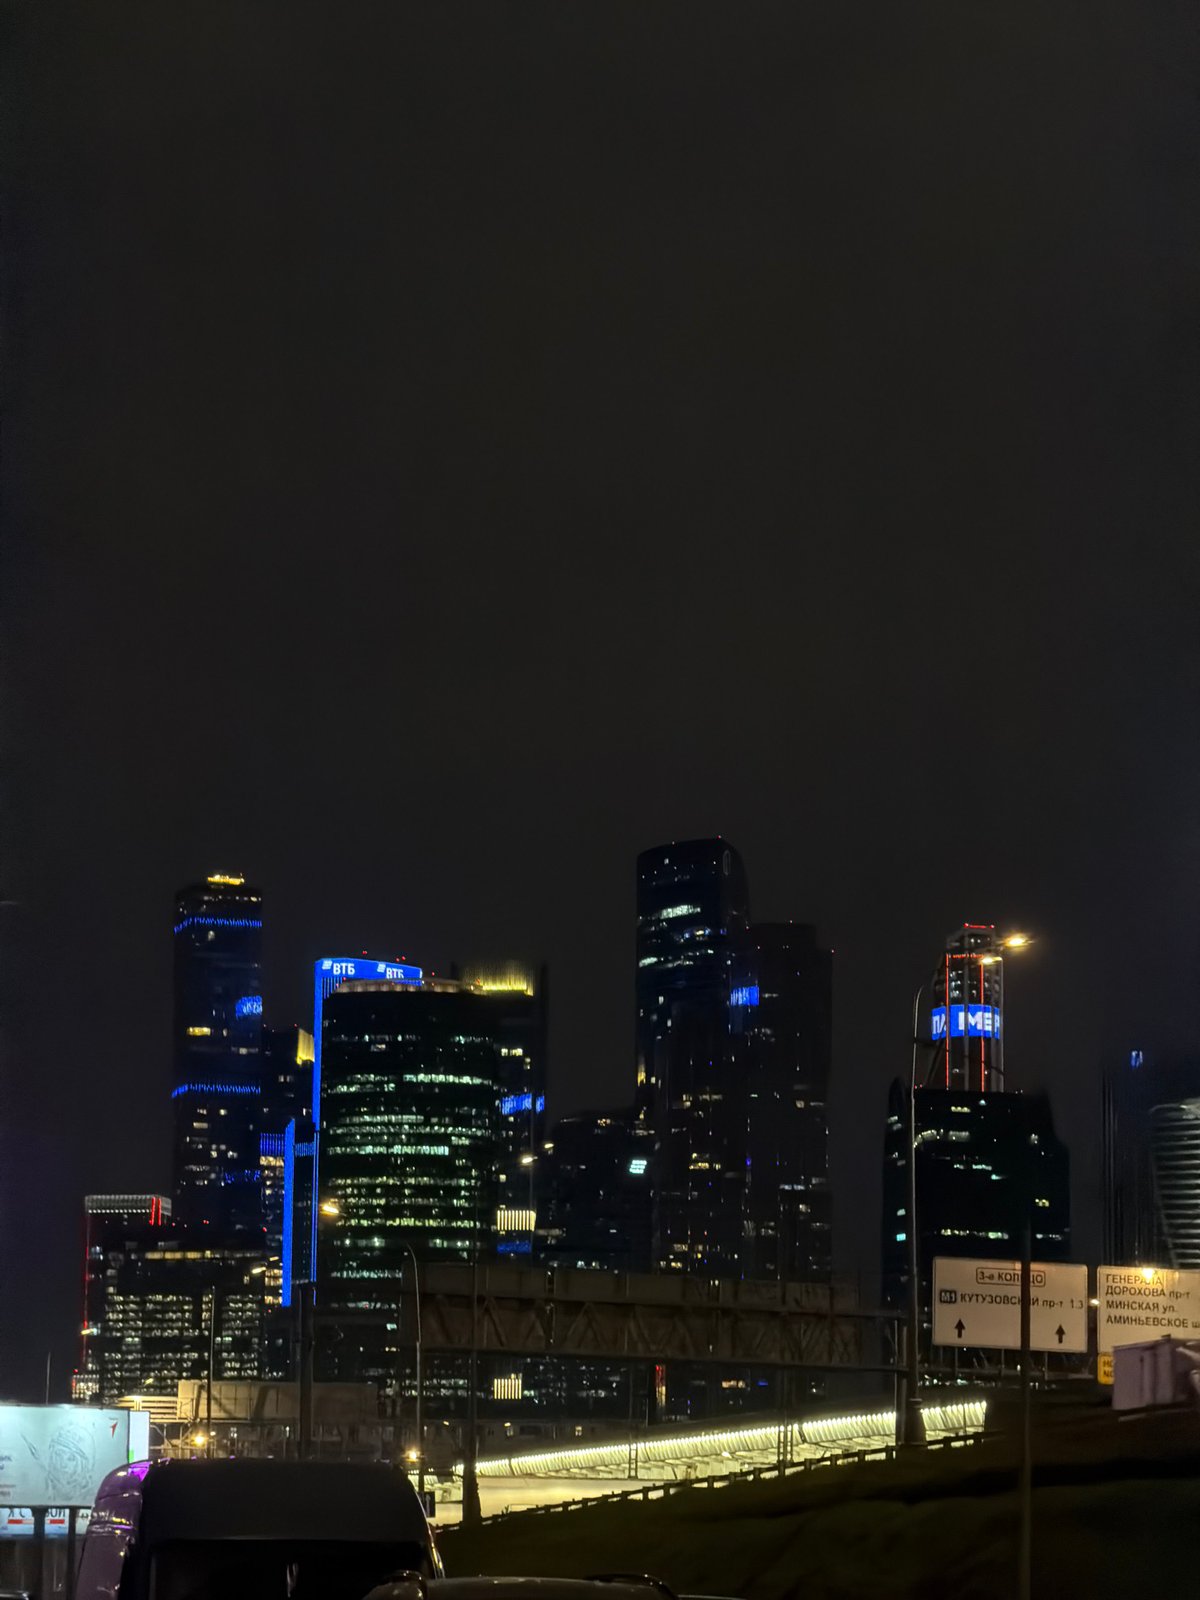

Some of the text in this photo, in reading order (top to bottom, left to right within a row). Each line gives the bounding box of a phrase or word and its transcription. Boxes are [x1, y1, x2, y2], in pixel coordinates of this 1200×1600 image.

[333, 963, 355, 975] ВТБ
[1105, 1285, 1166, 1298] ДОРОХОВА
[1106, 1300, 1160, 1311] МИНСКАЯ
[1106, 1315, 1189, 1328] АМИНЬЕВСКОЕ
